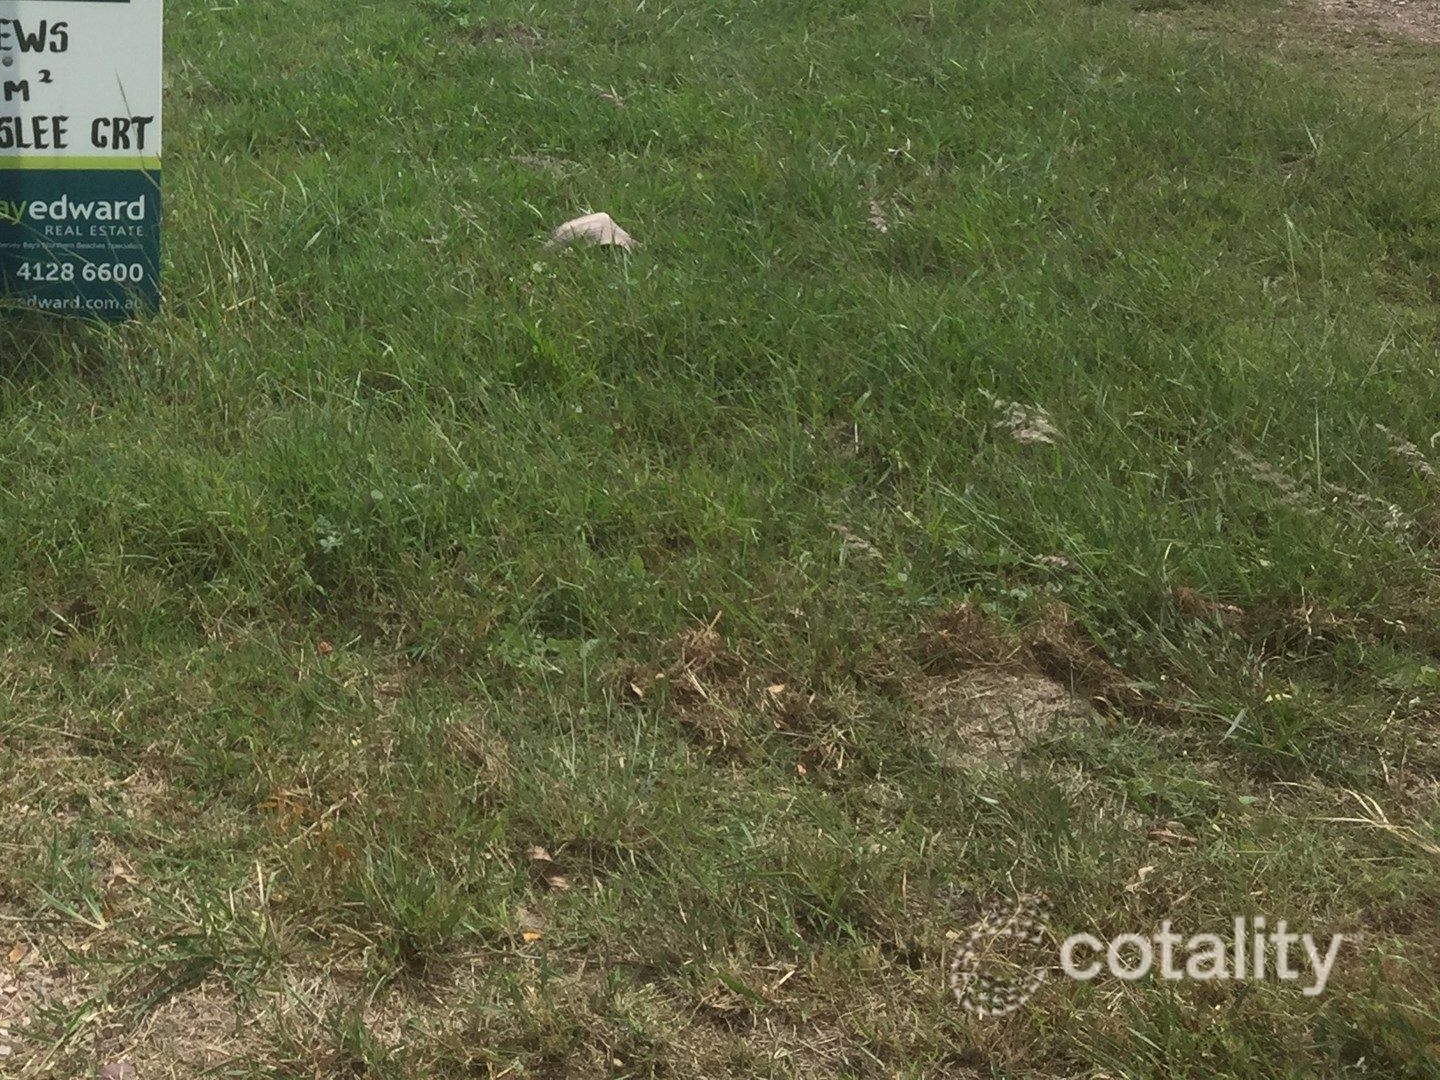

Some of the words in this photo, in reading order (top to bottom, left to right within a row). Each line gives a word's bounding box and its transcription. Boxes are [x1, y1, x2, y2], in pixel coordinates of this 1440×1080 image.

[90, 115, 155, 151] CRT
[44, 224, 84, 237] REAL
[89, 224, 145, 238] ESTATE
[16, 261, 75, 282] 4128
[81, 262, 145, 283] 6600
